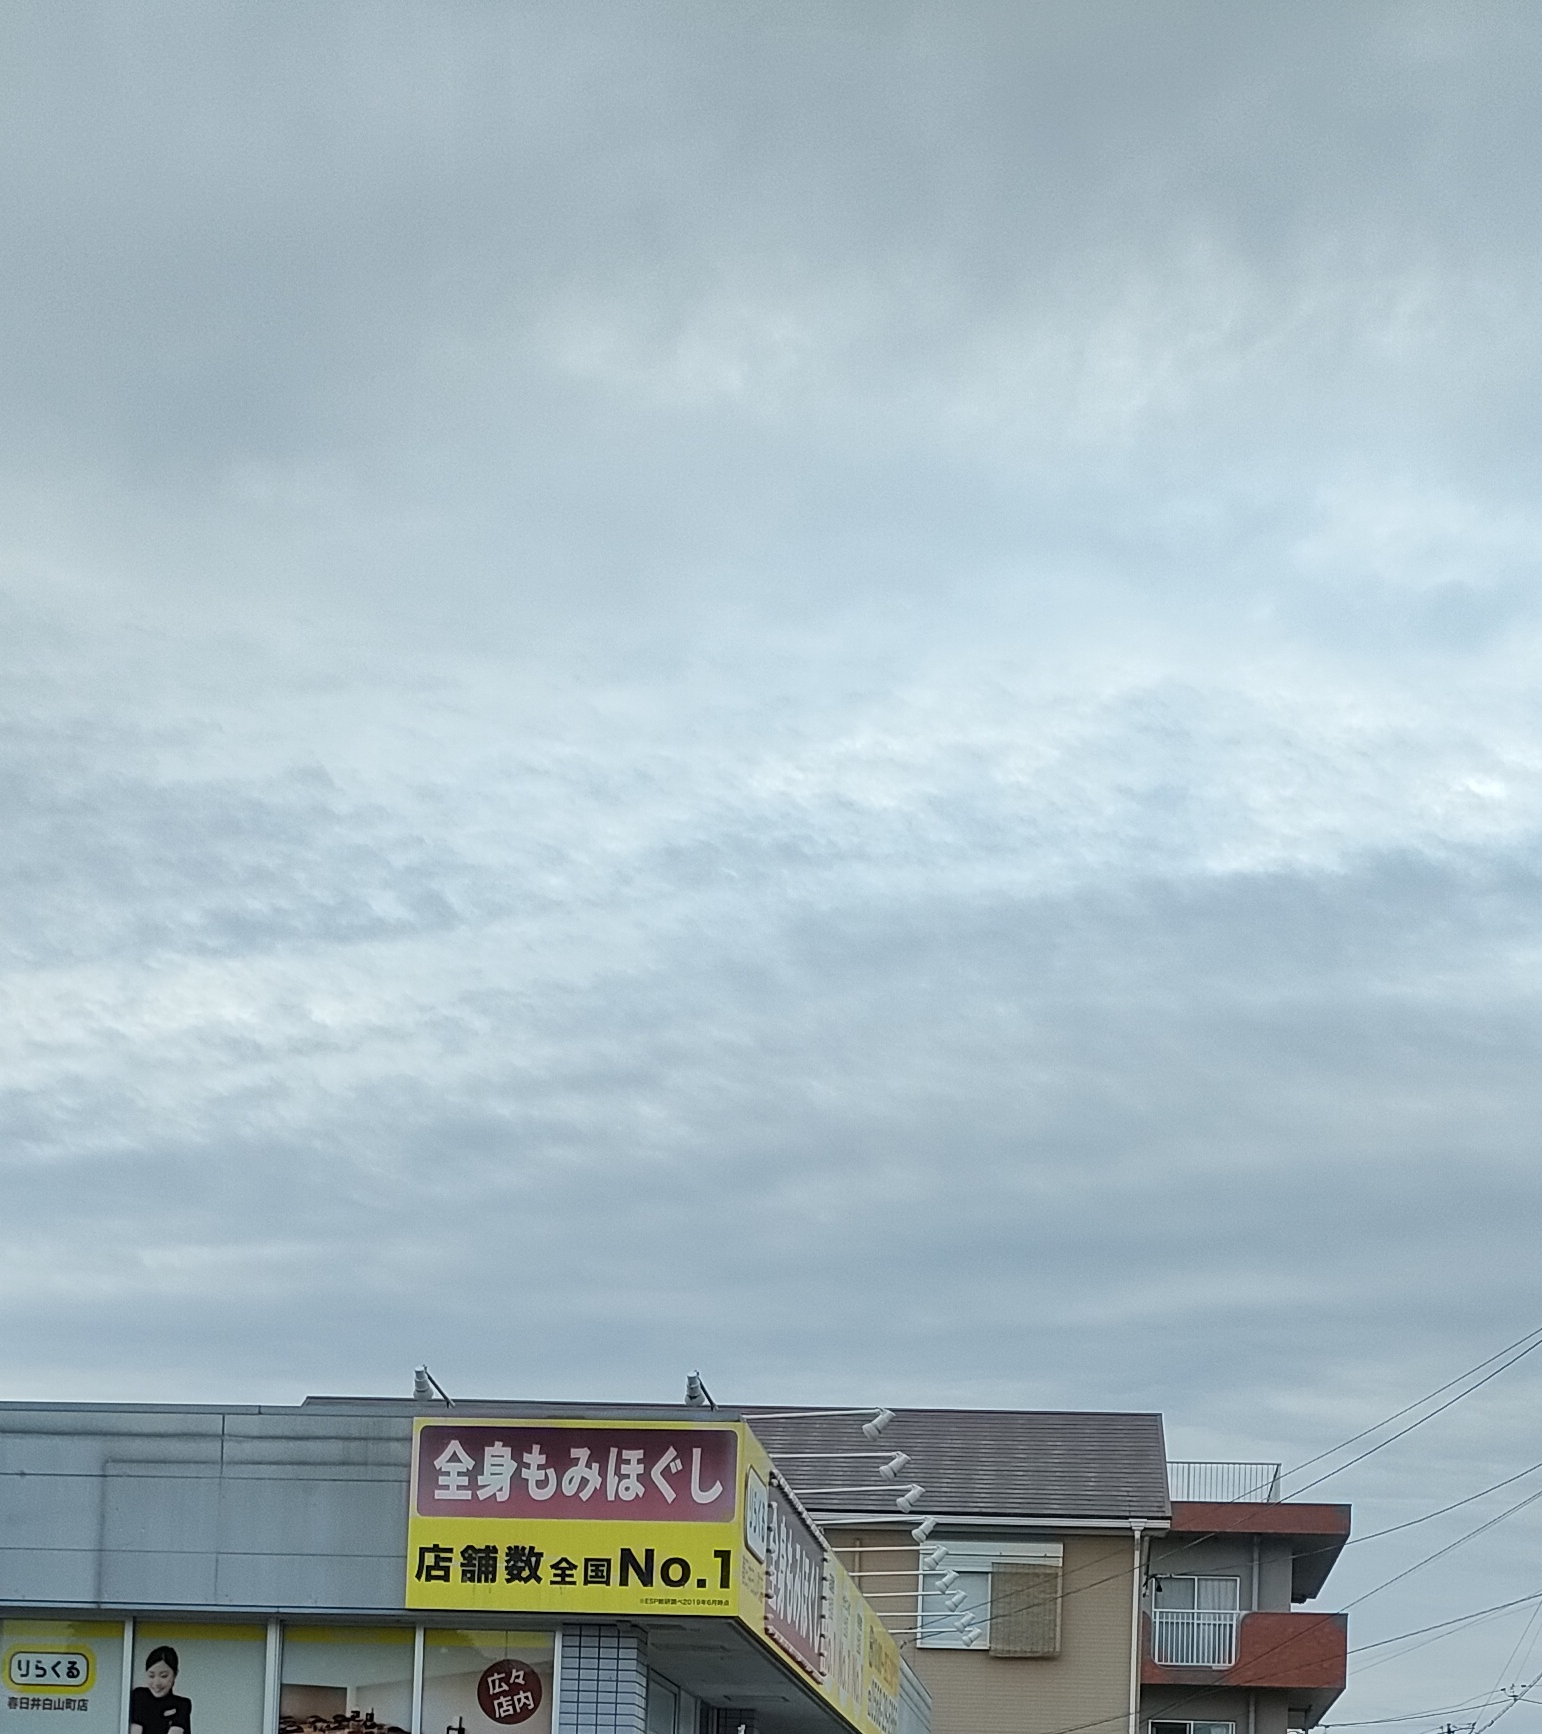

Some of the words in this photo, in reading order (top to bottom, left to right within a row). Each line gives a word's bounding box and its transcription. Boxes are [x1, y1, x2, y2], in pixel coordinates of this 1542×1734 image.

[433, 1439, 724, 1505] 全身もみほぐし
[414, 1543, 543, 1584] 店舗数
[548, 1557, 612, 1587] 全国
[618, 1549, 733, 1590] No.1
[17, 1659, 80, 1679] りらくる
[487, 1668, 527, 1694] 広々
[8, 1697, 89, 1711] 春日井白山町店
[493, 1692, 535, 1717] 店内
